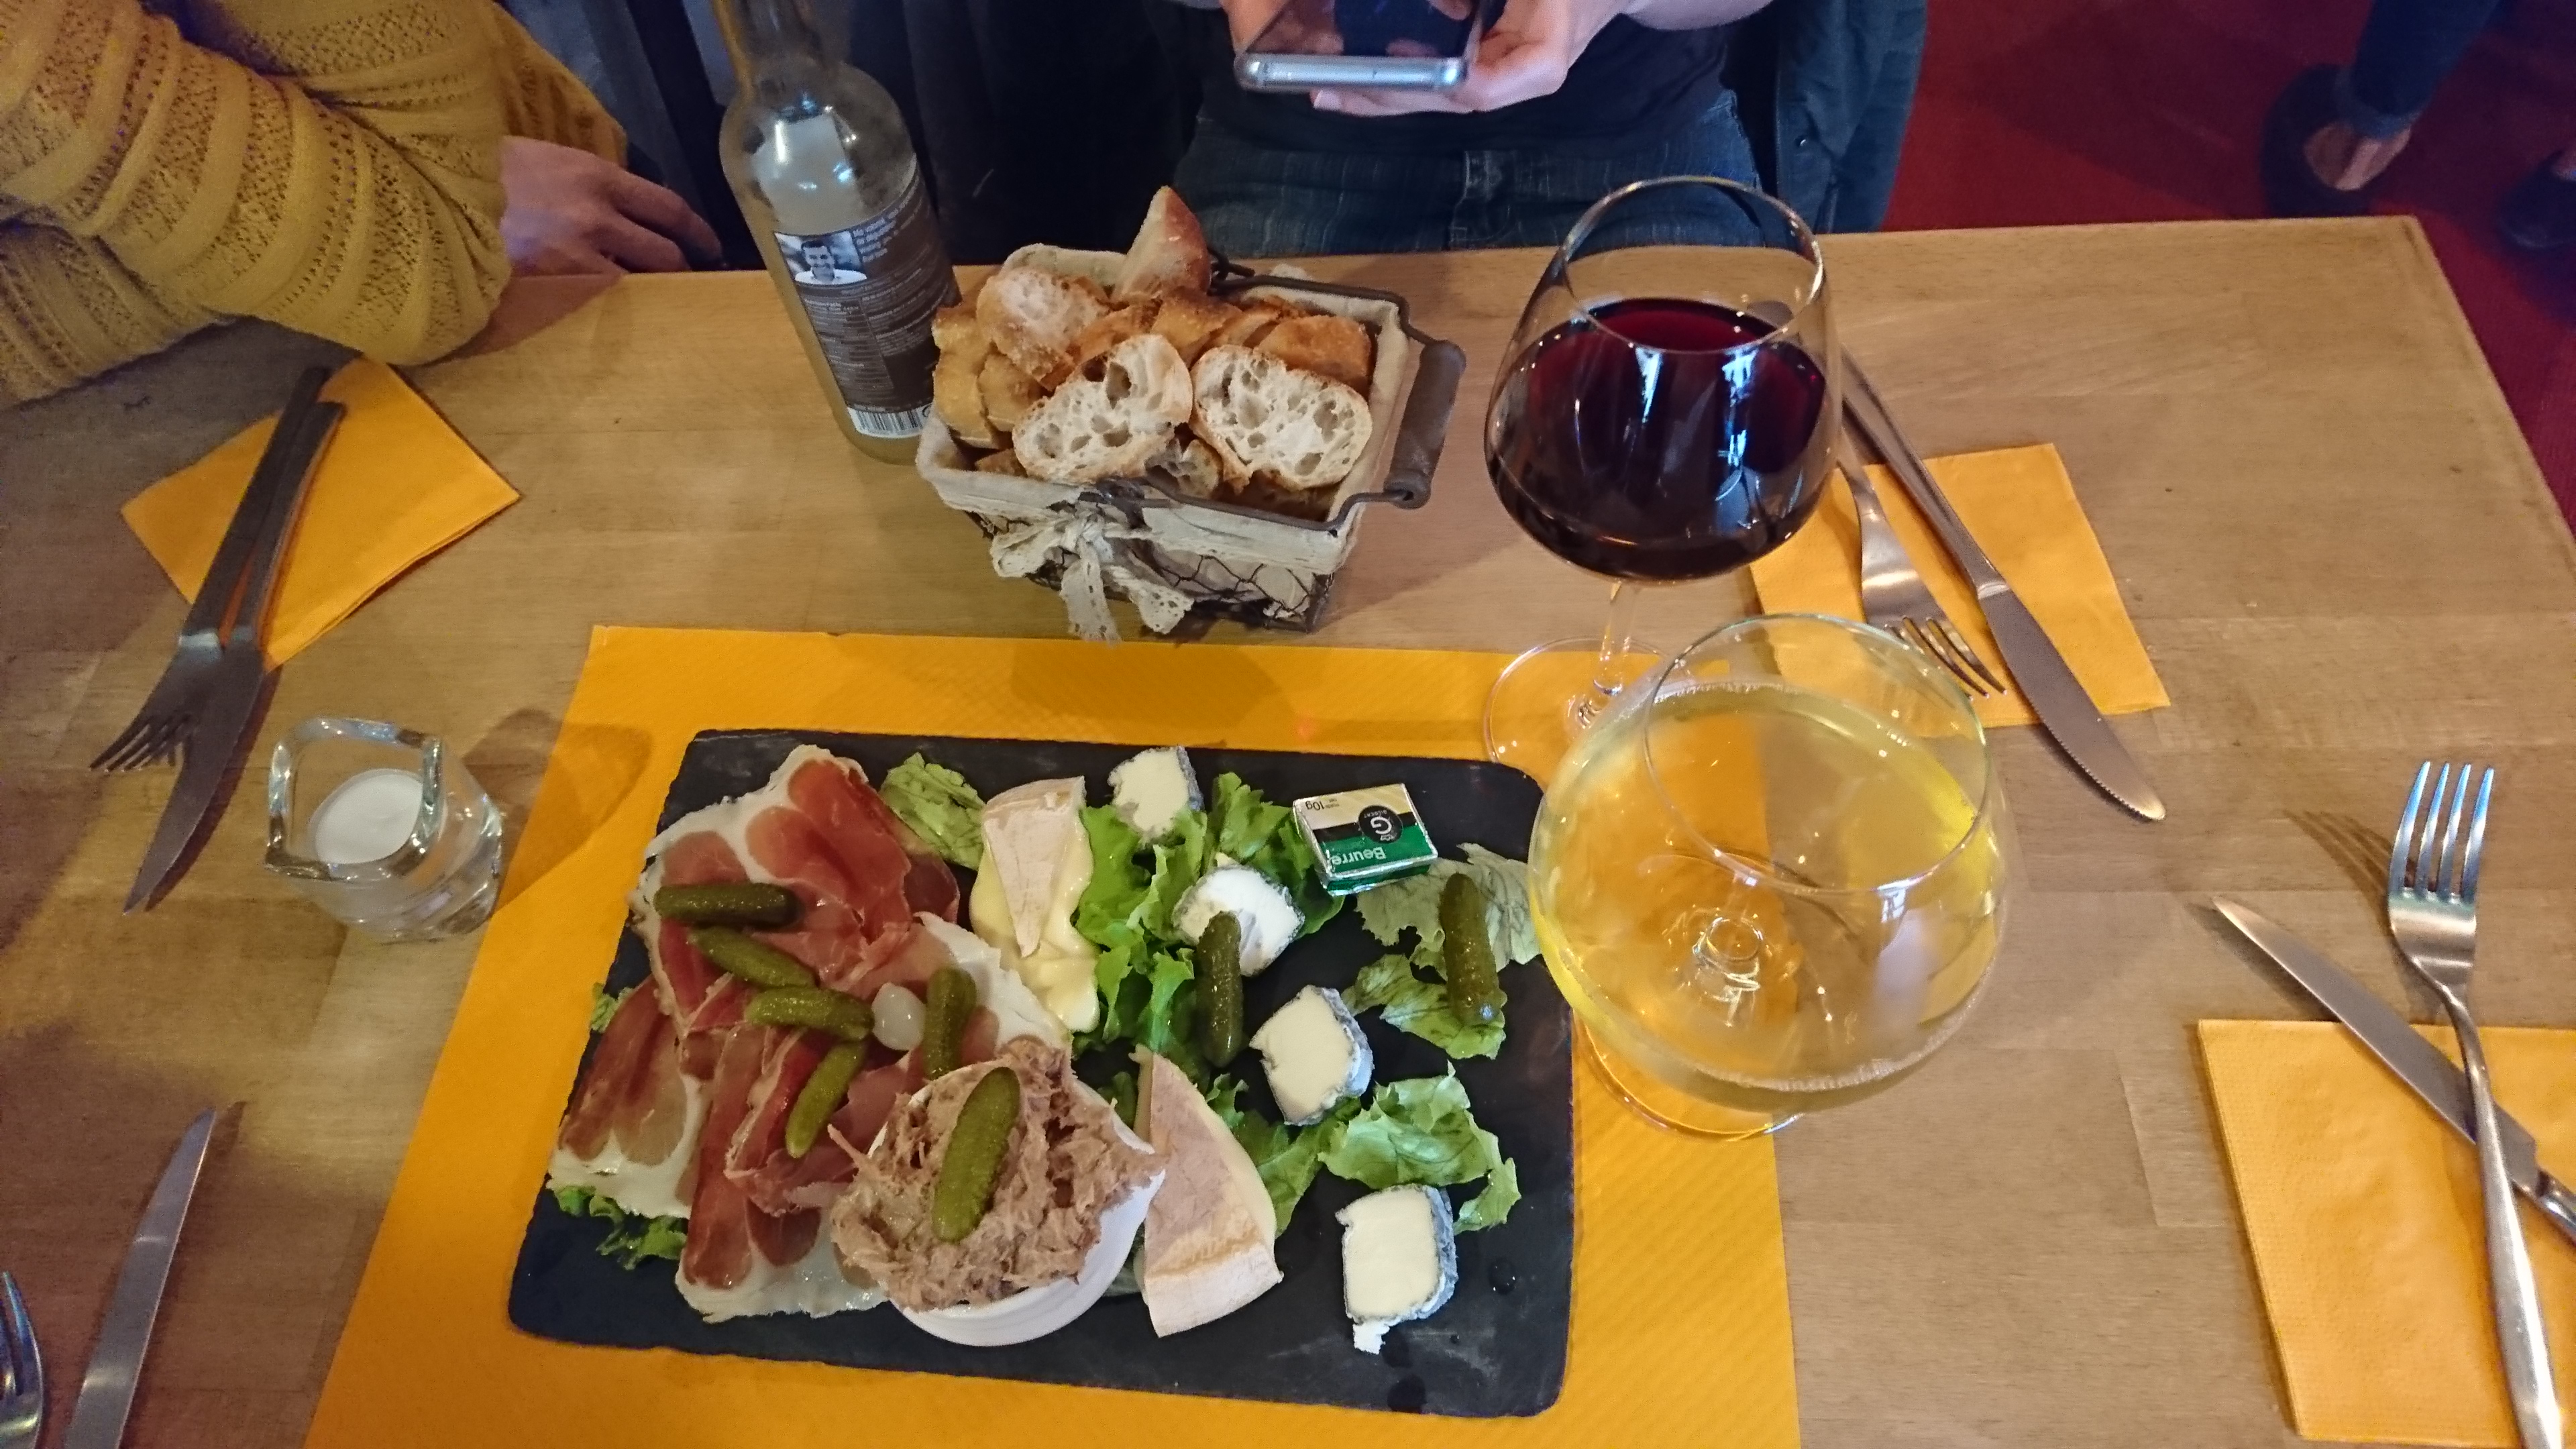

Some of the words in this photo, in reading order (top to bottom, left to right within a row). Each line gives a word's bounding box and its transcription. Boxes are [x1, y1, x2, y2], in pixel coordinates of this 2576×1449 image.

[1305, 800, 1325, 811] 10g
[1370, 816, 1393, 835] G
[1332, 847, 1387, 865] Beurre
